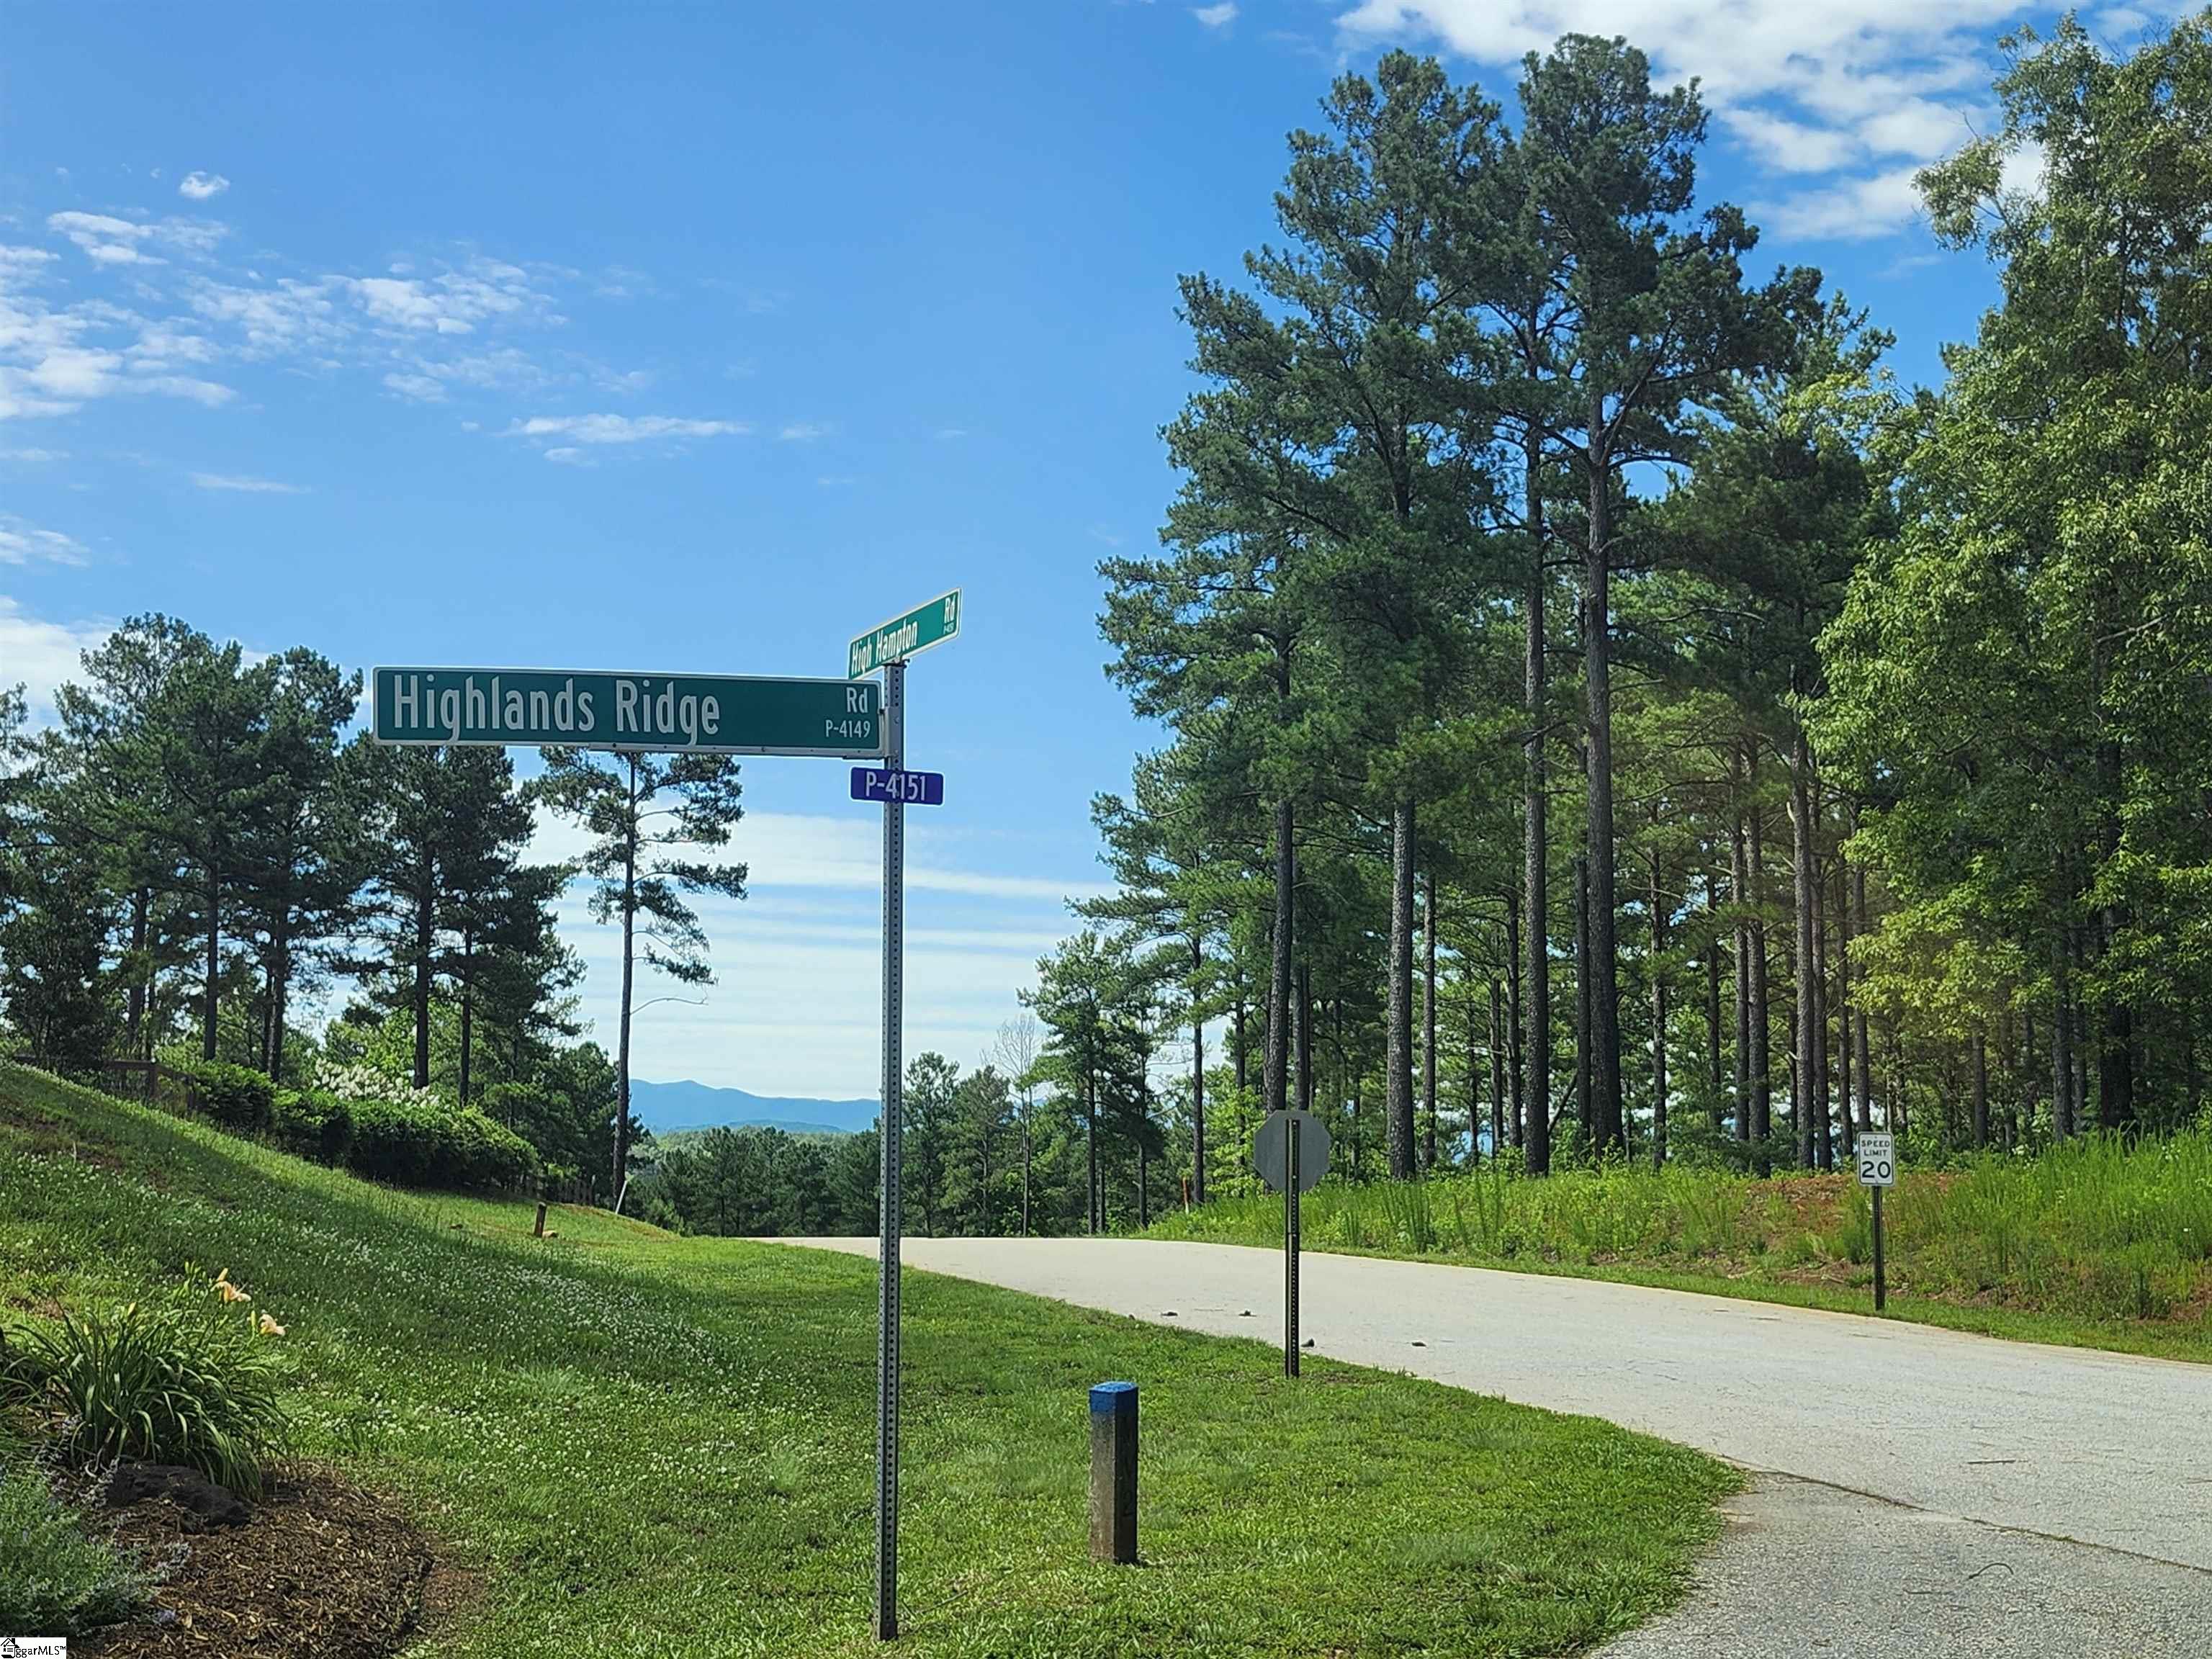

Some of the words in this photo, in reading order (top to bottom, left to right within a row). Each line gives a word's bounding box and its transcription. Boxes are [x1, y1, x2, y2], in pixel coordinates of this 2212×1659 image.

[851, 637, 873, 675] High
[875, 618, 918, 664] Hampton
[944, 595, 956, 624] Rd
[394, 674, 594, 743] Highlands
[616, 680, 720, 746] Ridge
[847, 687, 868, 714] Rd
[825, 719, 871, 738] P-4149
[866, 771, 926, 801] P-4151
[1862, 1161, 1891, 1179] 20
